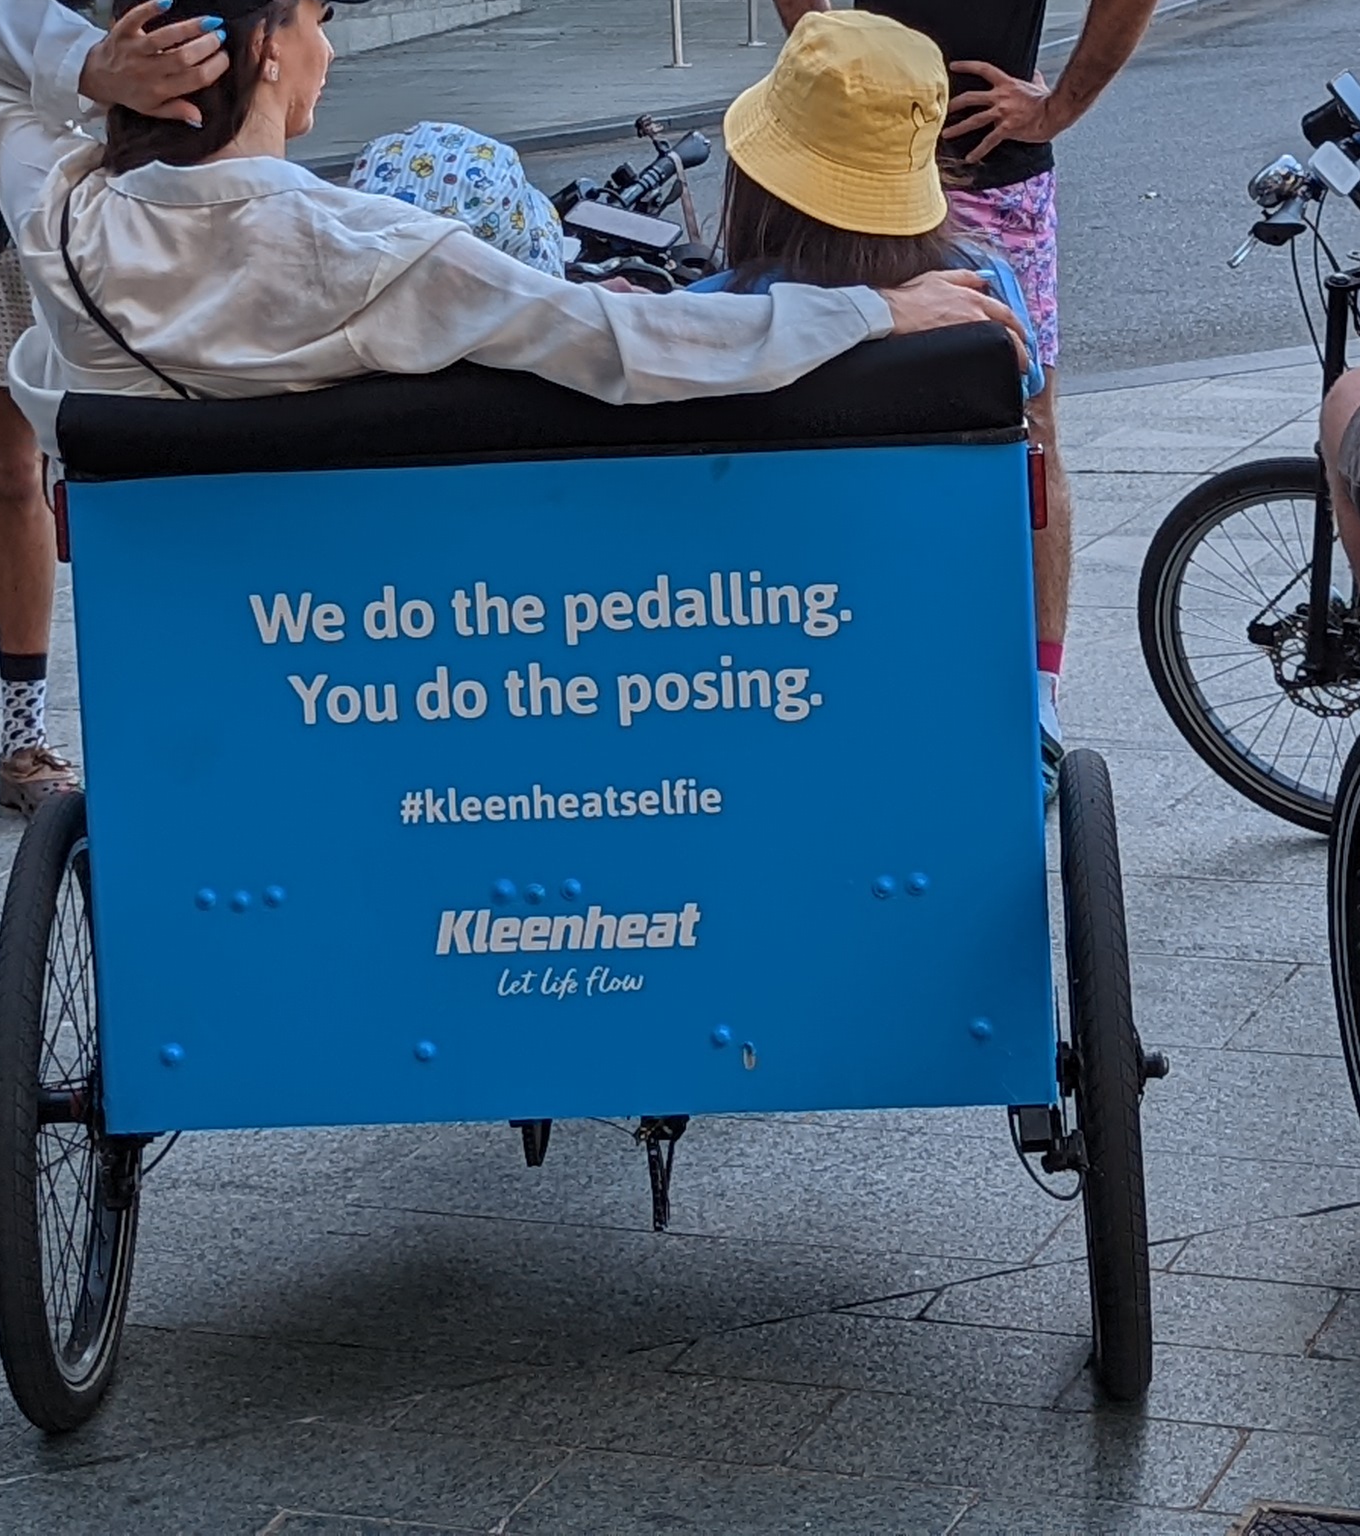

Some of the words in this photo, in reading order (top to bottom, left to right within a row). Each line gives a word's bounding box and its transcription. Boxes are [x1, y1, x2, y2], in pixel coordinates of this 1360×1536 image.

[248, 590, 346, 645] We
[362, 584, 436, 641] do
[450, 581, 546, 637] the
[563, 569, 853, 647] pedalling.
[286, 672, 399, 726] You
[415, 665, 489, 721] do
[503, 661, 600, 718] the
[616, 654, 823, 727] posing.
[399, 778, 723, 825] #kleenheatselfie
[435, 902, 702, 956] Kleenheat
